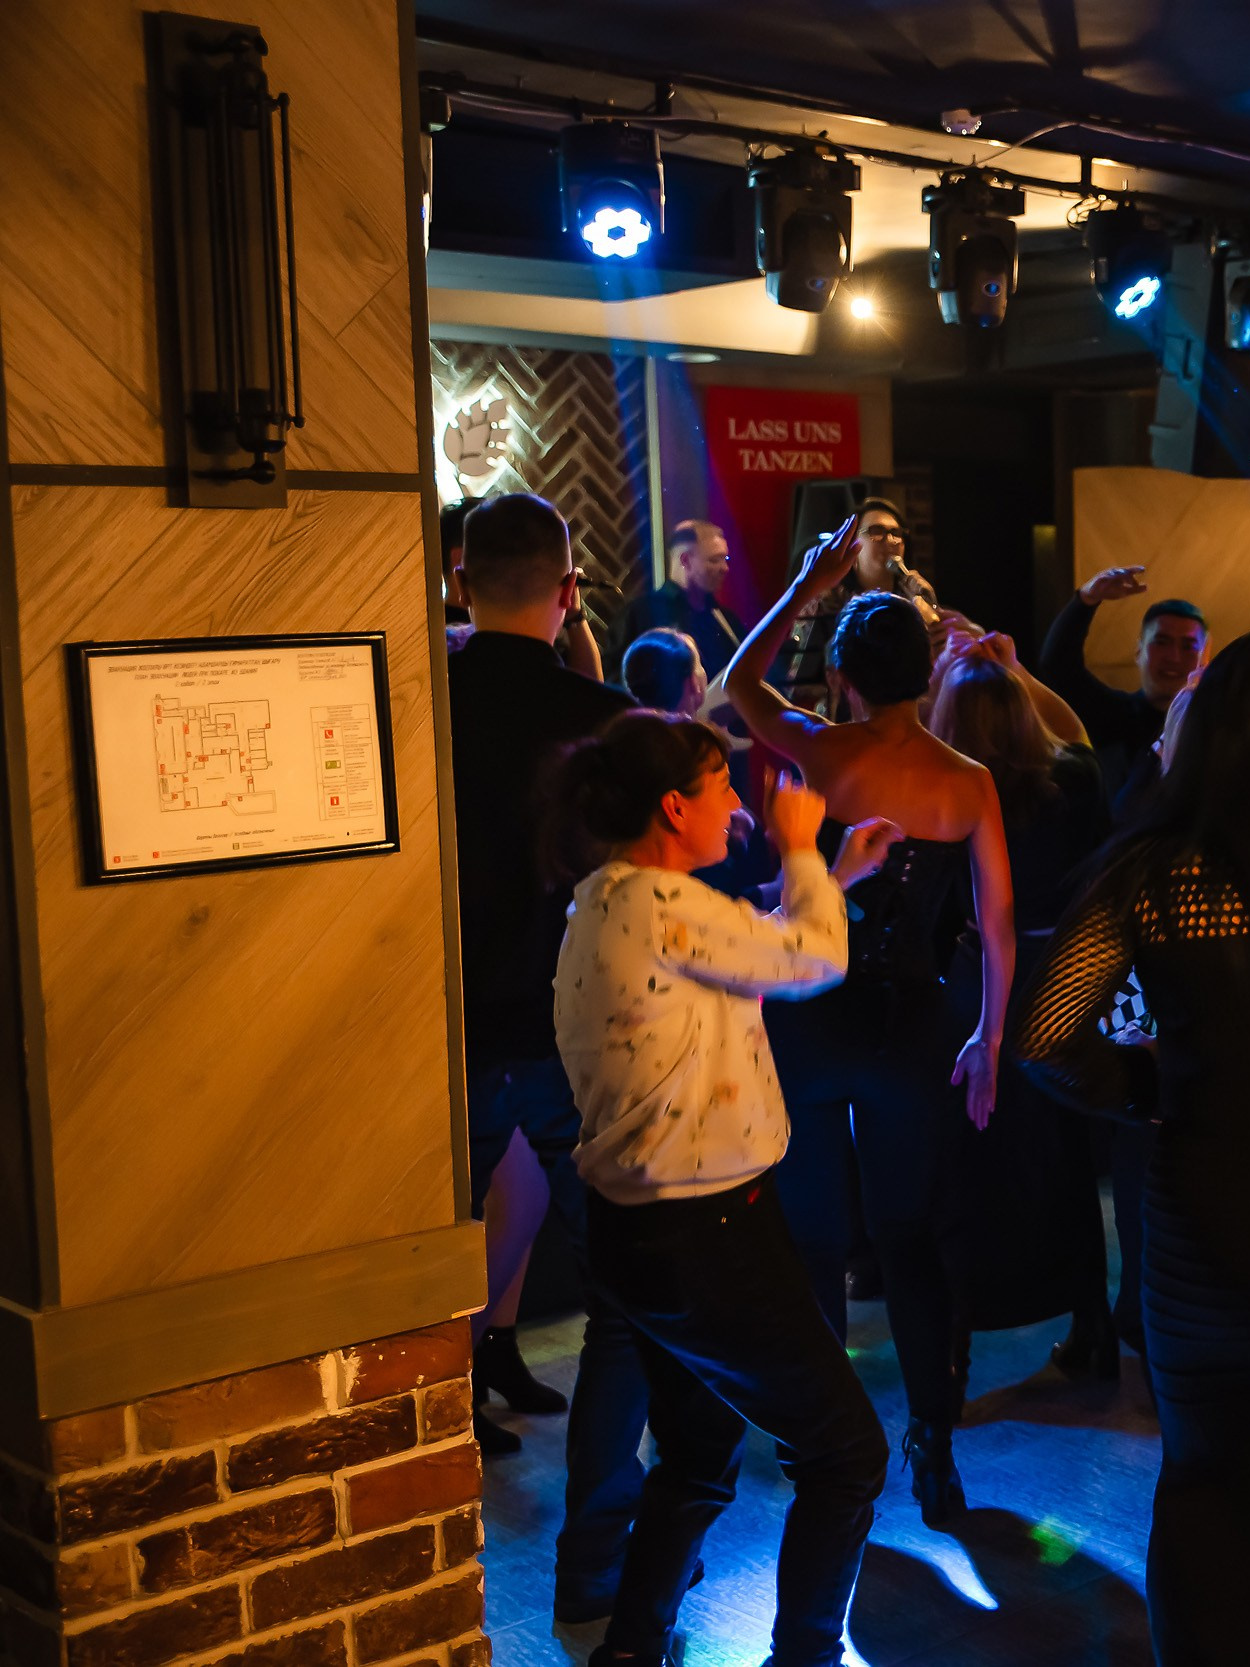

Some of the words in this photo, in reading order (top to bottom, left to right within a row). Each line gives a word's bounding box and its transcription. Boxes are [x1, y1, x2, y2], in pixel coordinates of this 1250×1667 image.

[728, 417, 788, 442] LASS
[793, 421, 842, 444] UNS
[738, 448, 833, 473] TANZEN
